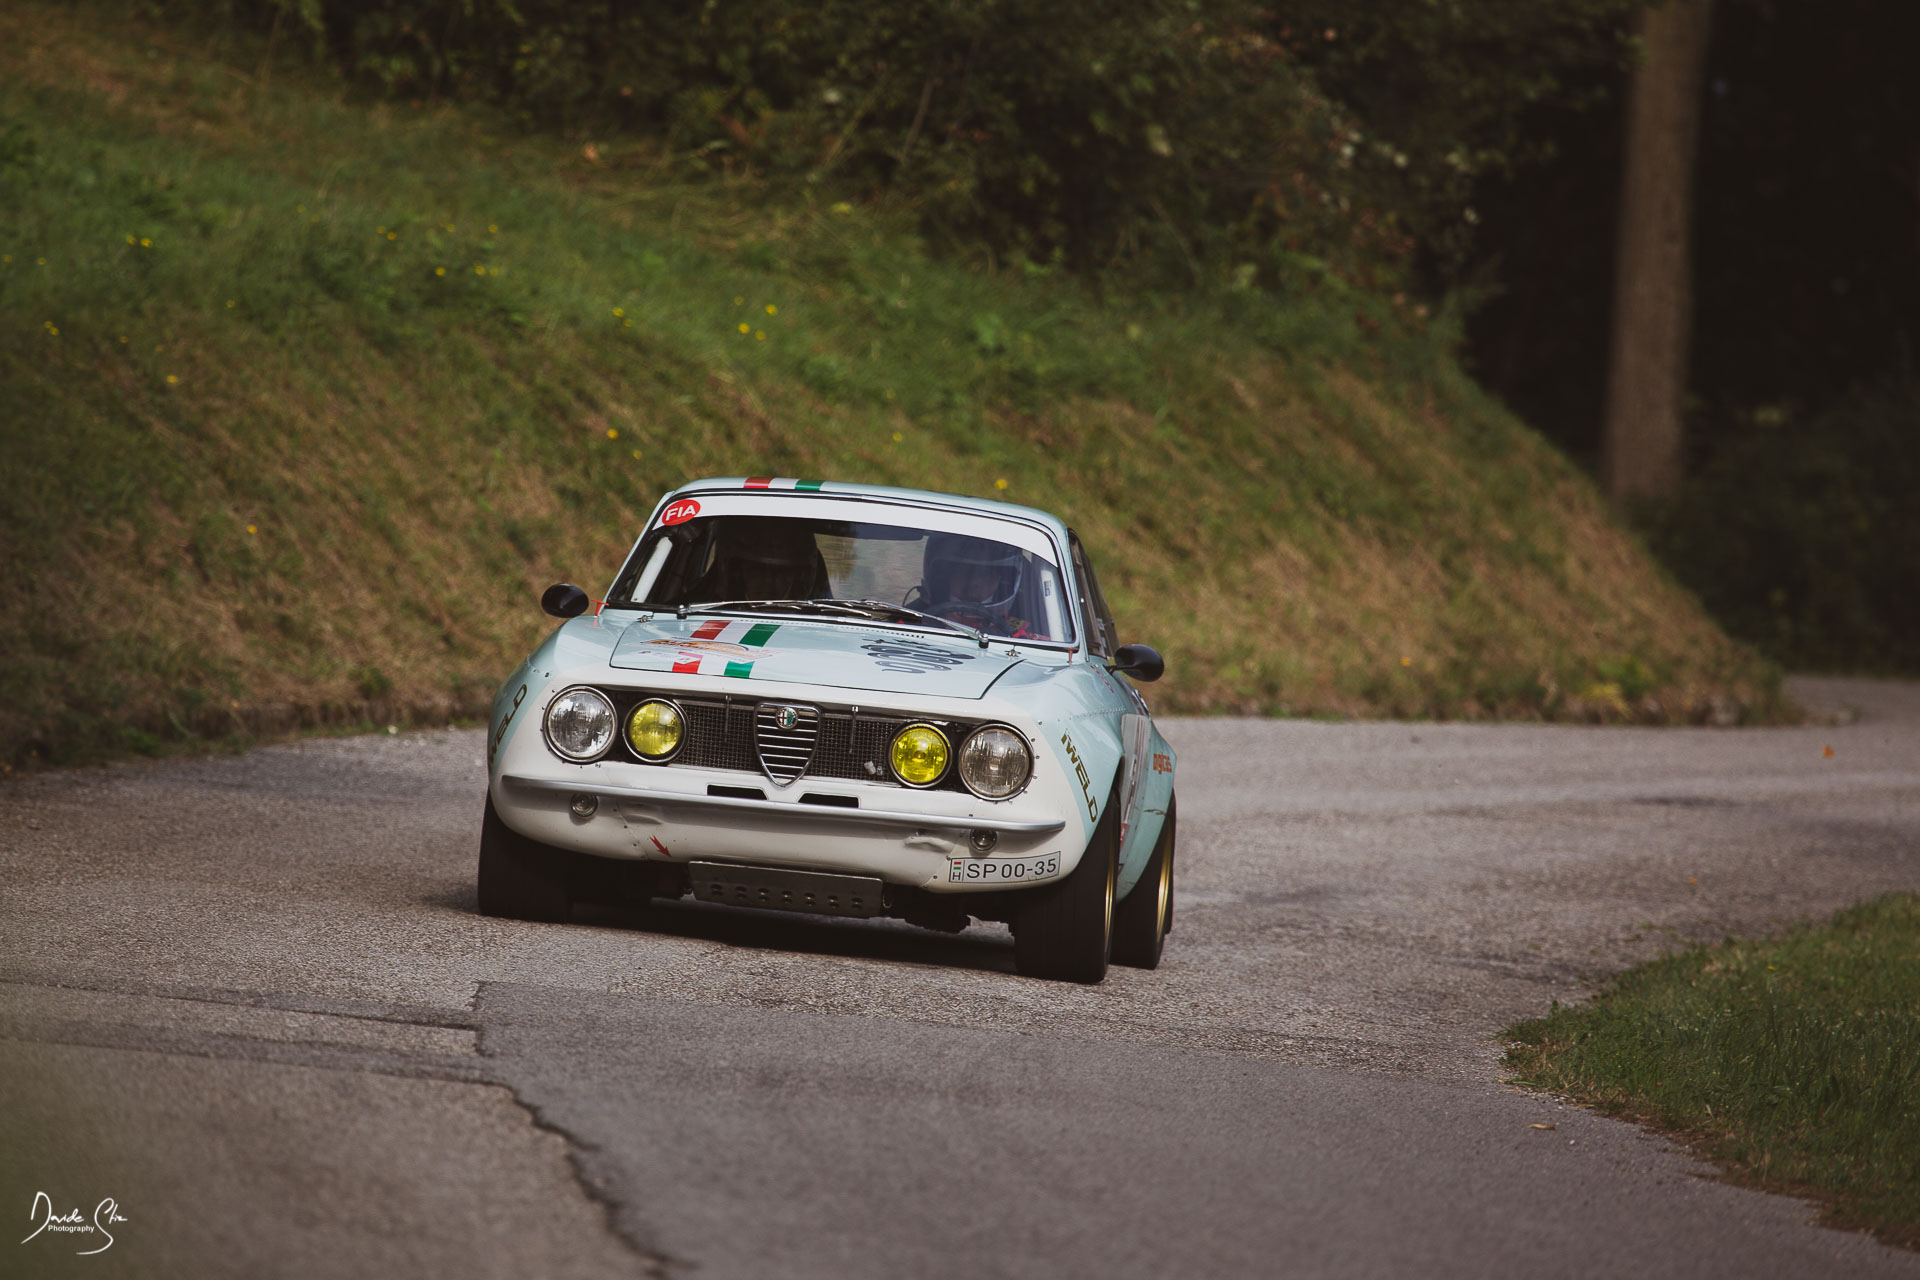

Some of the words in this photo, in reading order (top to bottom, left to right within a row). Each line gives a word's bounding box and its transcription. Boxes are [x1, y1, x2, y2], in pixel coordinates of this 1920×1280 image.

[665, 504, 696, 522] FIA
[952, 871, 961, 881] H
[966, 863, 997, 879] SP
[1001, 858, 1057, 878] 00-35
